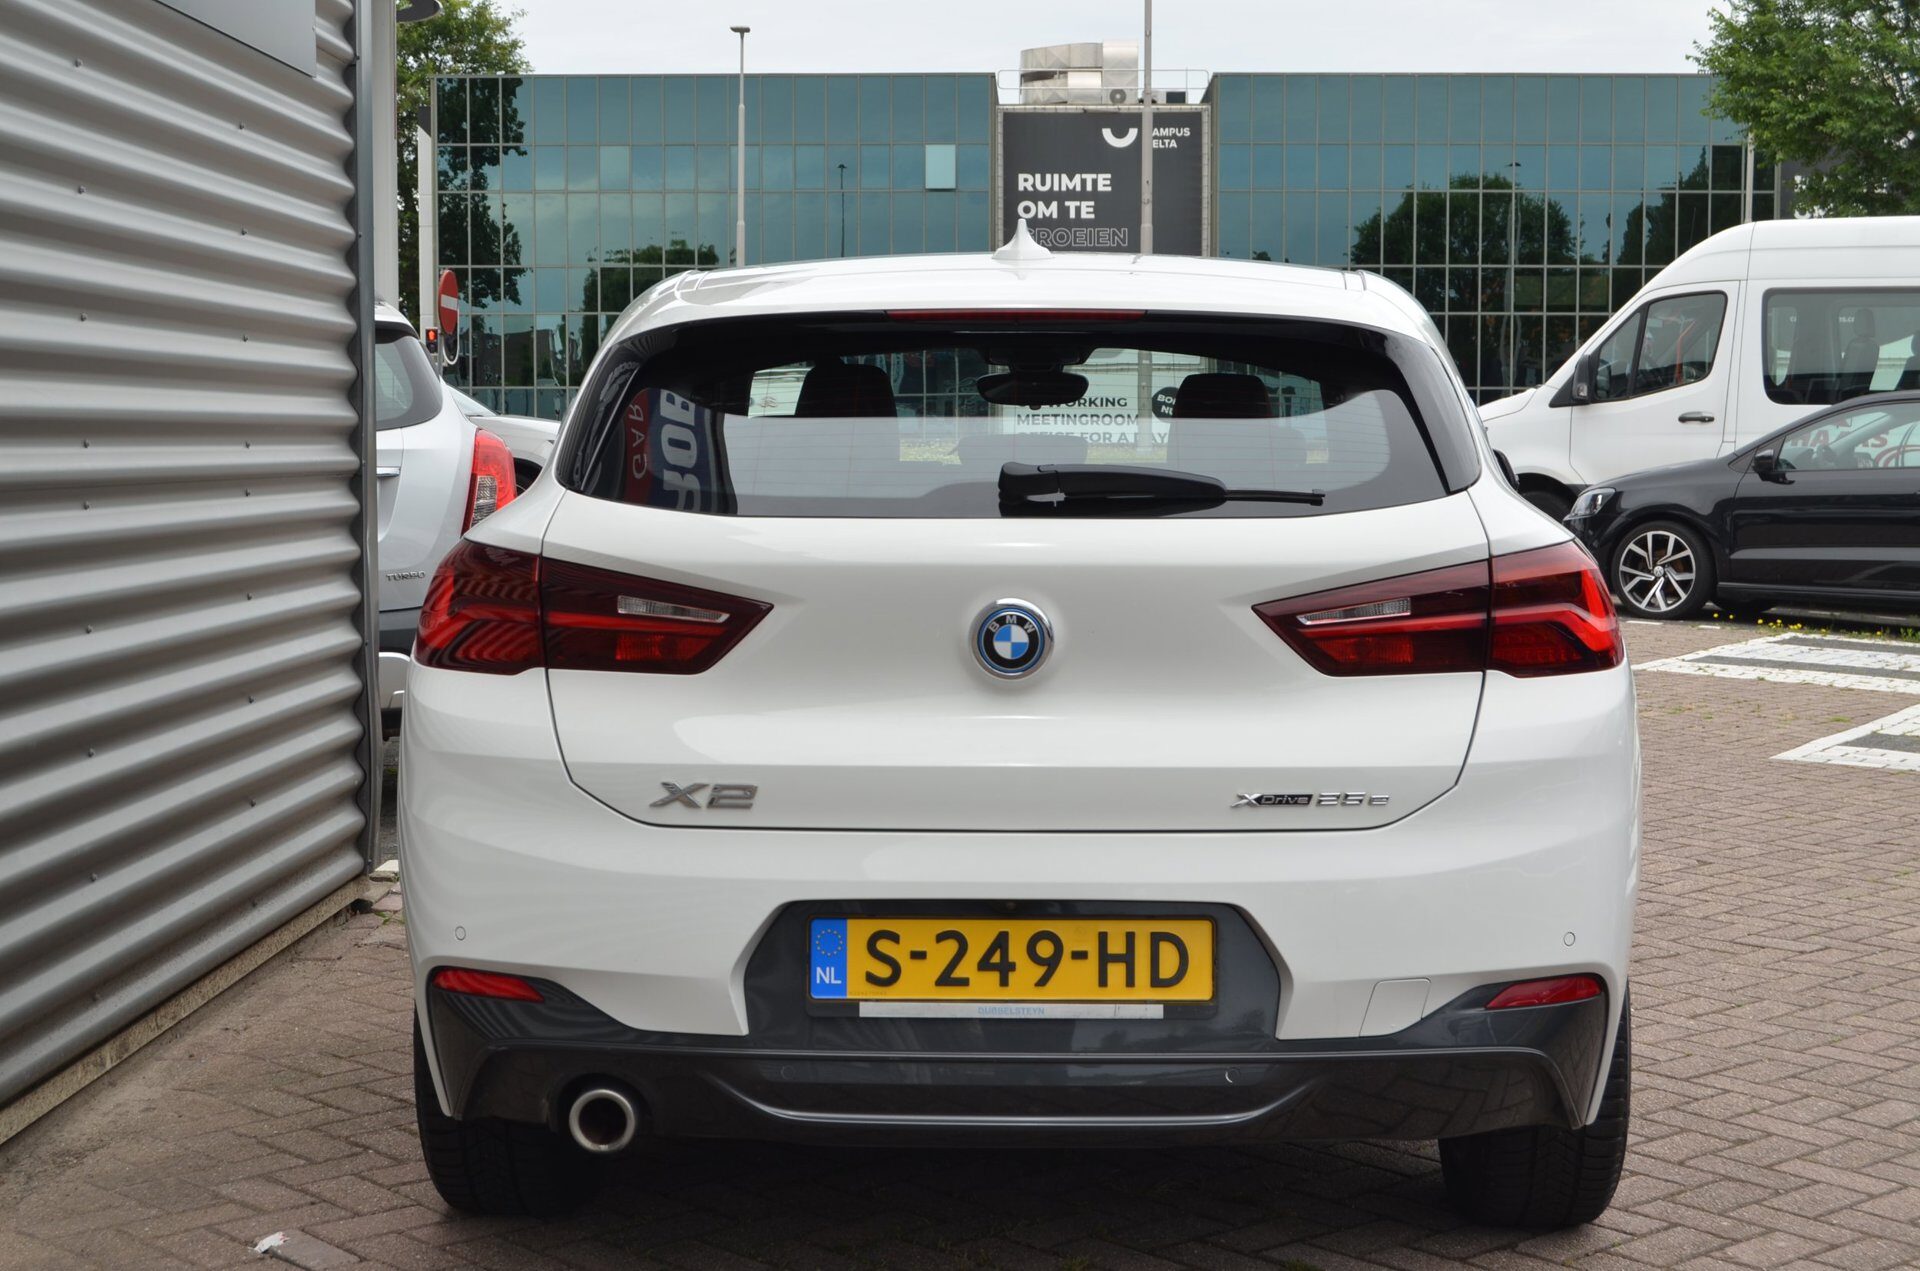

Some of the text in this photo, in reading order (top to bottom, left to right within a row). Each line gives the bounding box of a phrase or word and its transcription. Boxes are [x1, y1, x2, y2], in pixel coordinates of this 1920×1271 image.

[1151, 127, 1191, 137] AMPUS
[1152, 139, 1178, 148] ELTA
[1018, 173, 1112, 192] RUIMTE
[1017, 200, 1095, 219] OM TE
[1156, 394, 1177, 406] BO
[385, 570, 426, 582] TURBO
[988, 615, 1035, 633] BMW
[649, 781, 759, 809] X2
[865, 929, 1190, 988] S-249-HD
[815, 966, 843, 985] NL
